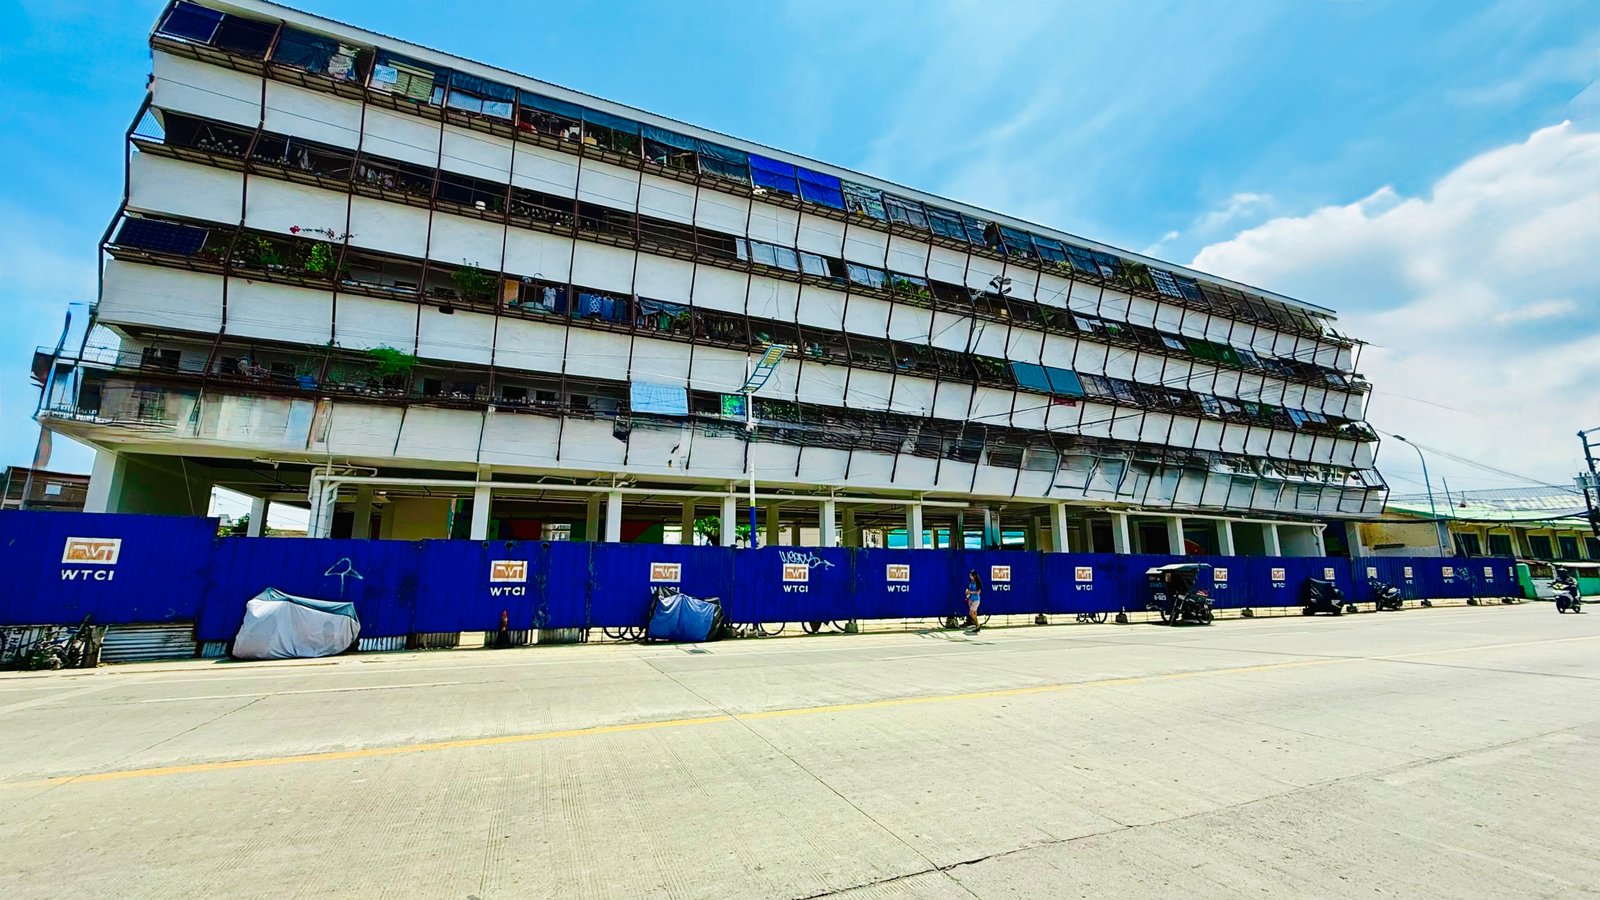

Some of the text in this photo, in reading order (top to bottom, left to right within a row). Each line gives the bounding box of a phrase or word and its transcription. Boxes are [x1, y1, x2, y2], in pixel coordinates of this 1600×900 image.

[61, 569, 115, 581] WTCI
[490, 586, 526, 597] WTCI
[783, 584, 809, 593] WTCI
[887, 584, 910, 593] WTCI
[991, 584, 1011, 592] WTCI
